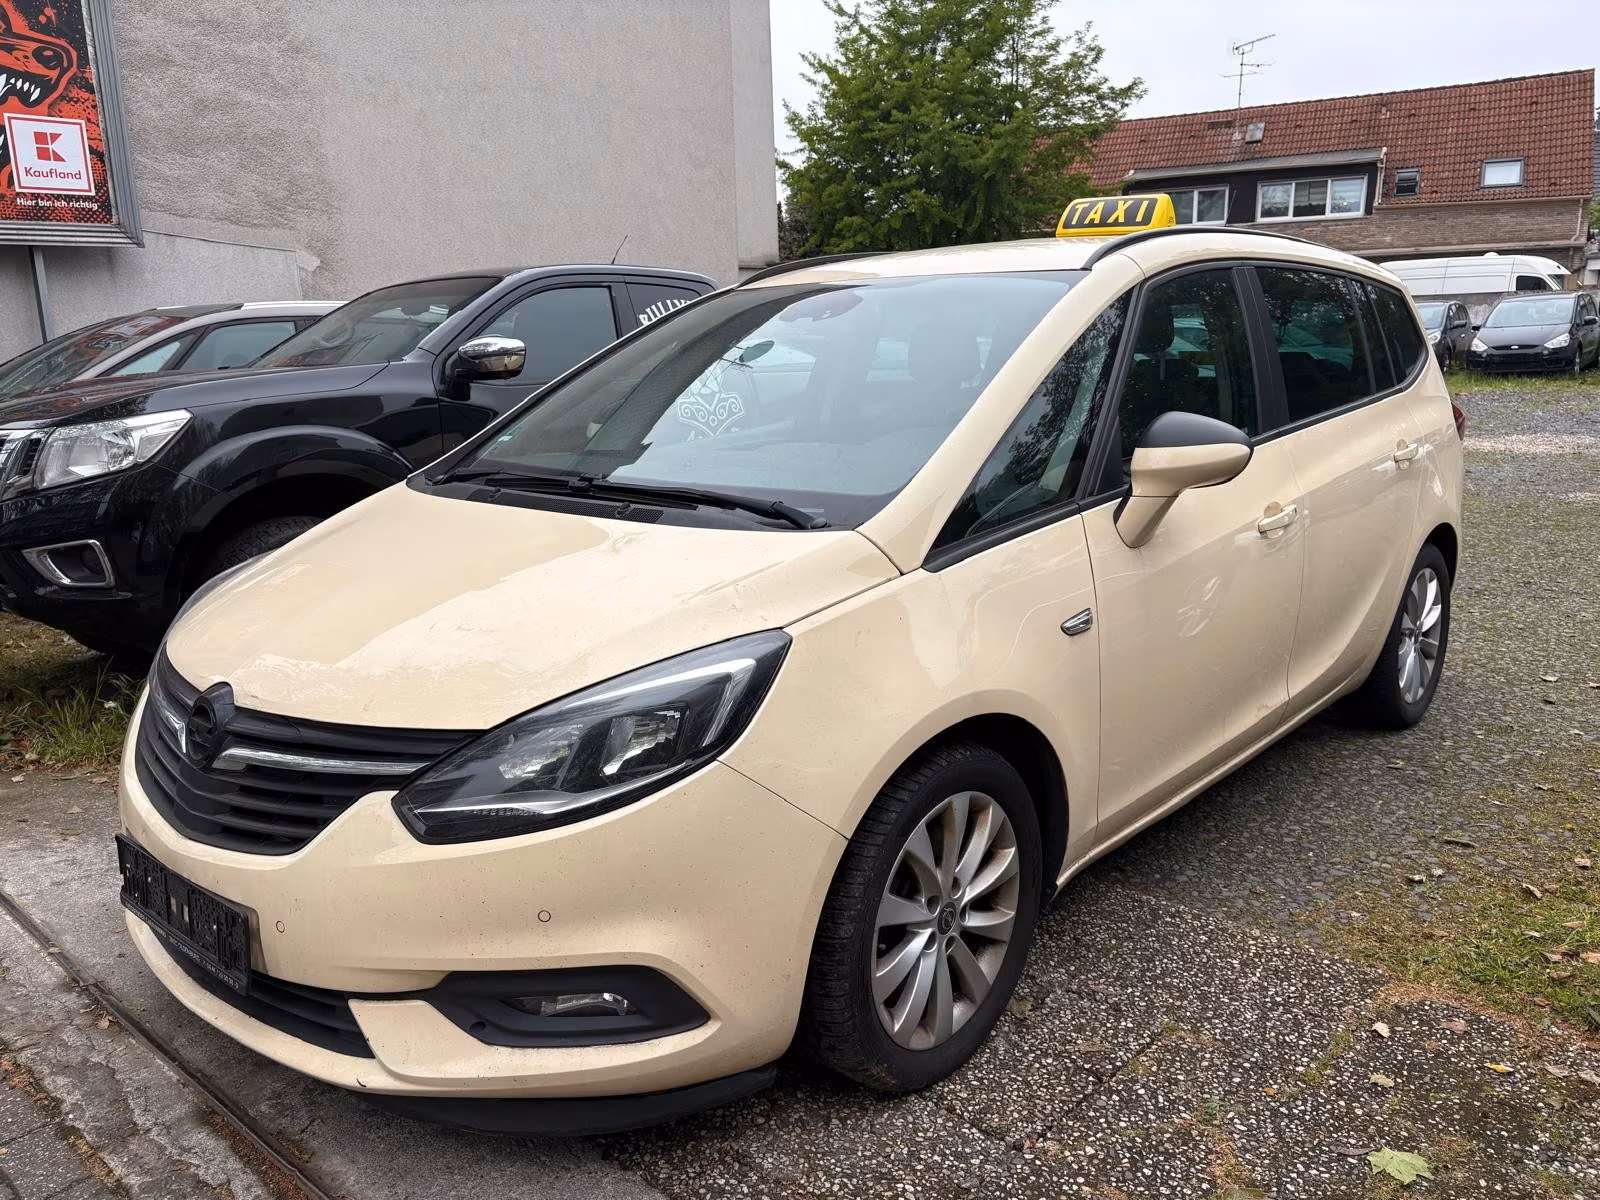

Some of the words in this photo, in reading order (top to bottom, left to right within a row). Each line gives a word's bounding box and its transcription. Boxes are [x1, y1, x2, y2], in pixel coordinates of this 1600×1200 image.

[24, 166, 82, 180] Kaufland
[16, 197, 37, 206] Hier
[38, 198, 53, 207] bin
[54, 199, 68, 208] ich
[69, 201, 98, 211] richtig
[1071, 200, 1150, 225] TAXI
